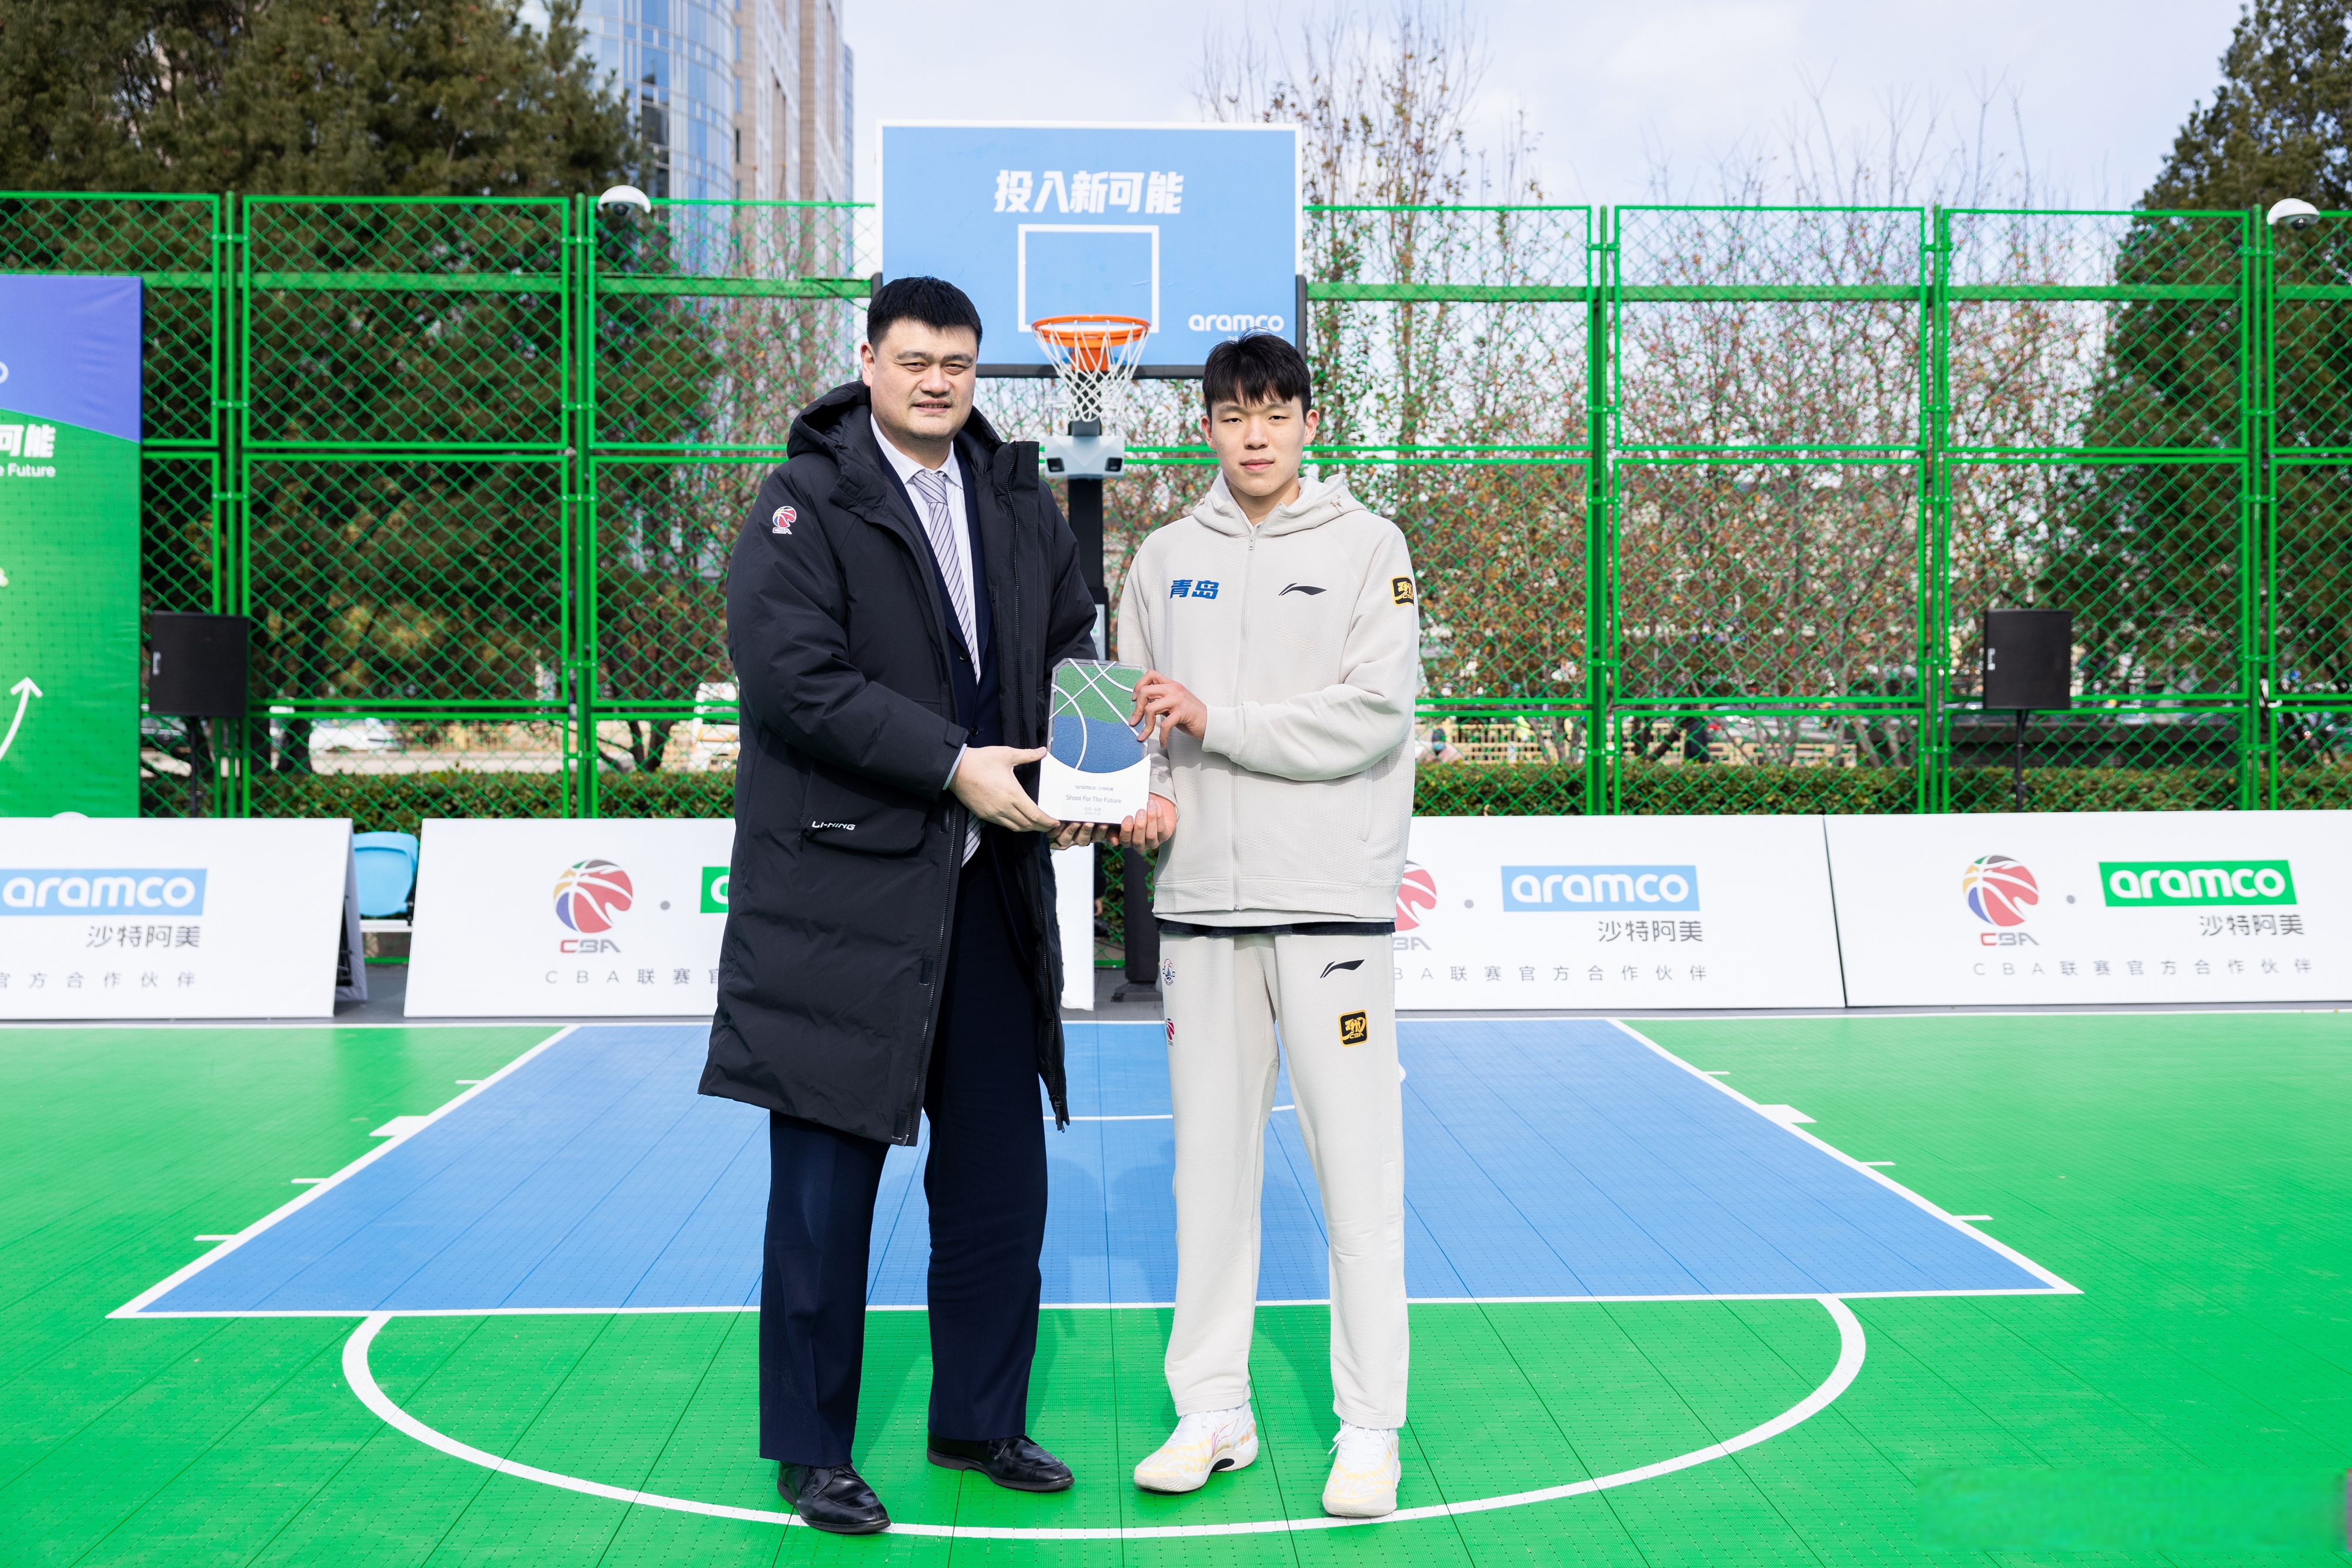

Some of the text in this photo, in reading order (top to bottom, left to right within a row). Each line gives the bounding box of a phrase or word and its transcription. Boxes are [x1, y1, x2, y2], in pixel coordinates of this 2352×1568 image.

[993, 169, 1184, 215] 投入新可能
[1188, 314, 1285, 332] aramco
[8, 462, 56, 477] Future
[1169, 579, 1219, 600] 青岛
[811, 821, 856, 831] LI-NING
[2, 876, 196, 908] aramco
[1511, 874, 1689, 903] aramco
[2109, 868, 2286, 899] aramco
[1598, 920, 1703, 942] 沙特阿美
[2199, 914, 2304, 936] 沙特阿美
[86, 925, 201, 948] 沙特阿美
[560, 939, 622, 953] CBA
[1392, 936, 1432, 951] BA
[1980, 932, 2040, 946] CBA
[1349, 1031, 1364, 1039] CBA
